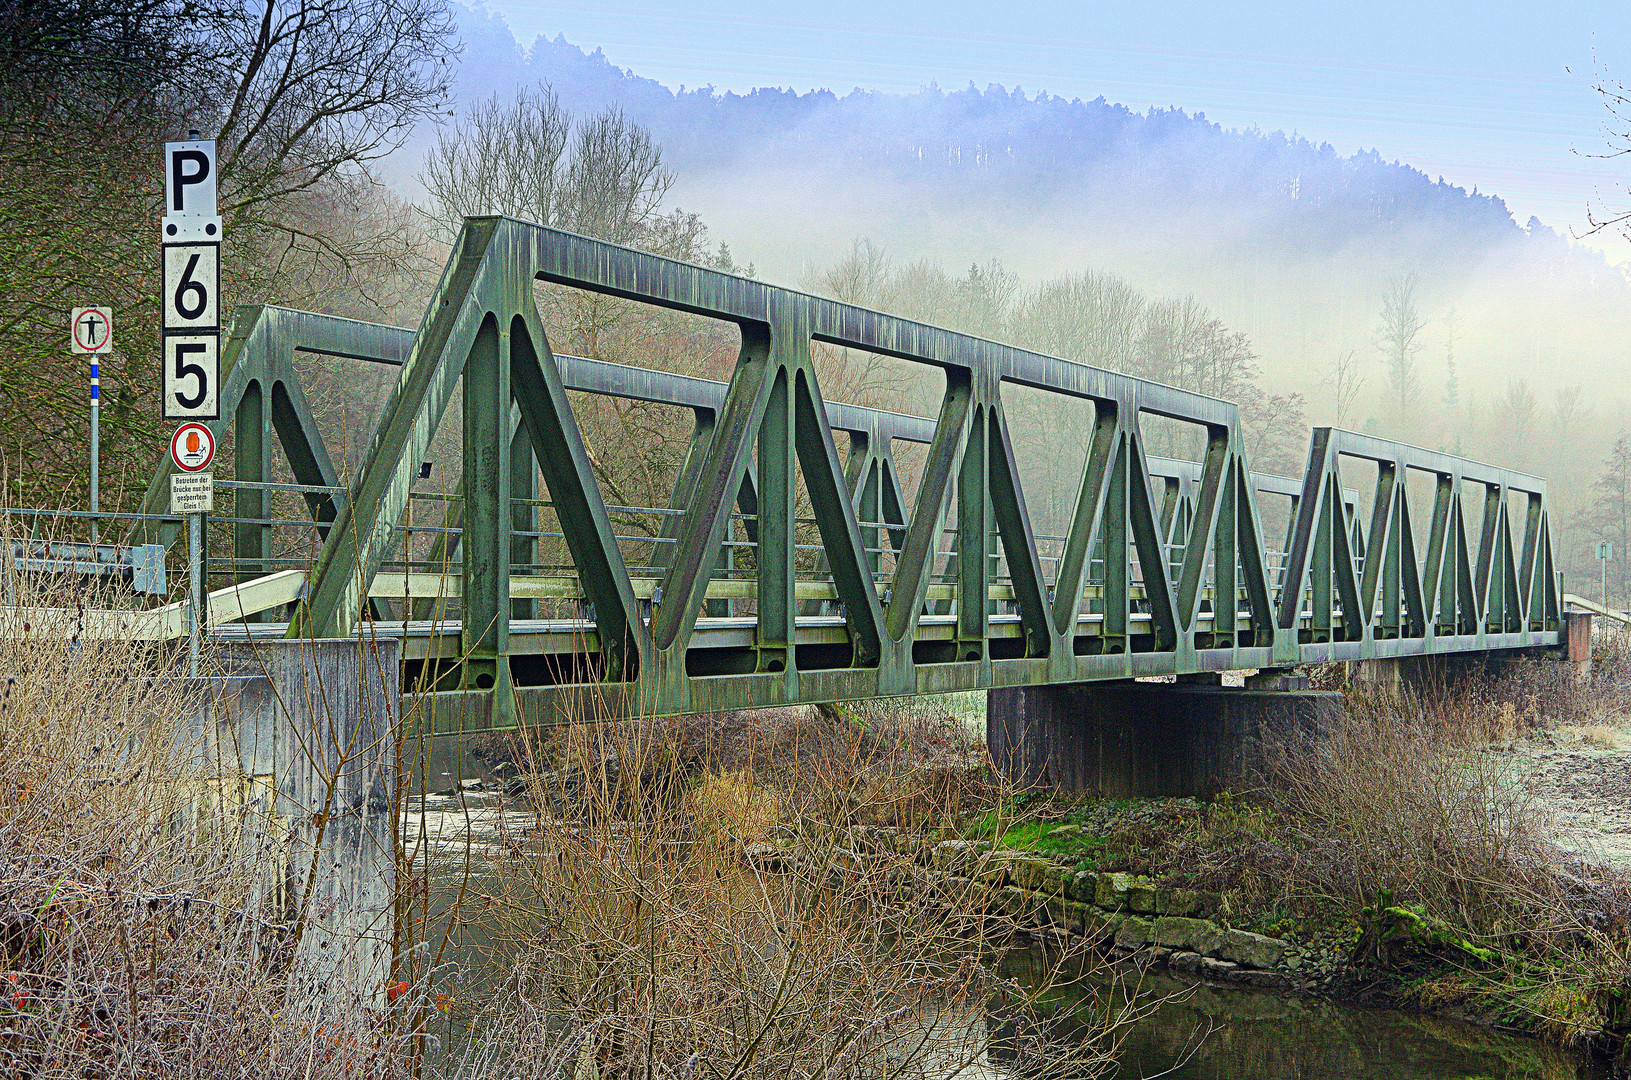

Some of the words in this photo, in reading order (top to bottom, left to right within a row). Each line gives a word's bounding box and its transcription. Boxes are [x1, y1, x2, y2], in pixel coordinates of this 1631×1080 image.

[173, 151, 210, 211] P
[174, 253, 208, 320] 6
[174, 343, 208, 410] 5
[173, 485, 191, 493] Brücke
[177, 494, 207, 503] gesperrtem
